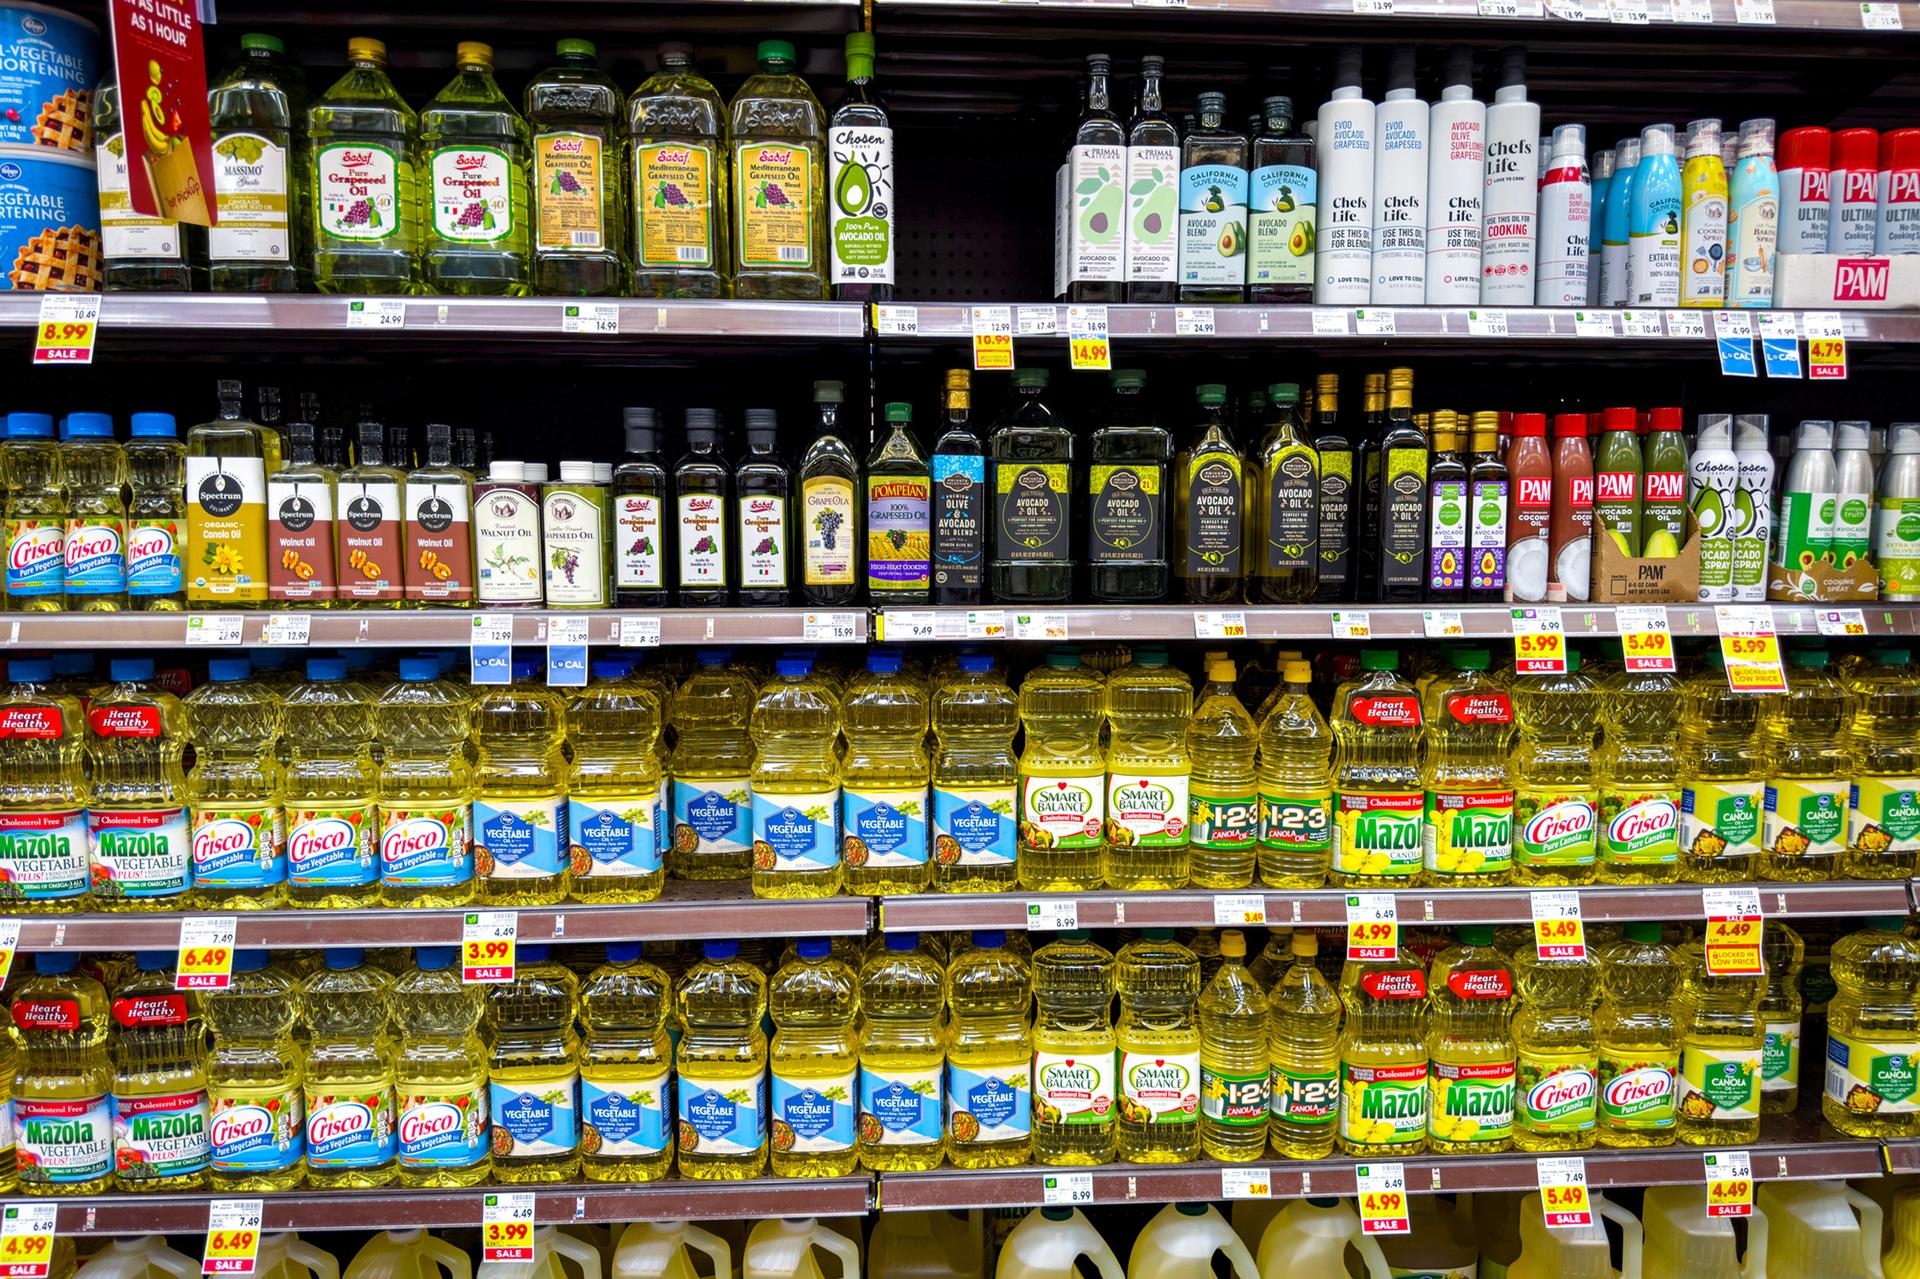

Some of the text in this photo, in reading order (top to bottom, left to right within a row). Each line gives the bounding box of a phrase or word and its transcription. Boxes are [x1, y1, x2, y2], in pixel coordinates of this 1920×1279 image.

[1373, 2, 1392, 10] 13.99
[136, 1, 191, 30] AS LITTLE
[131, 16, 186, 47] AS 1 HOUR
[1386, 121, 1403, 131] EVOO
[836, 132, 885, 145] Chosen
[1385, 131, 1415, 140] AVOCADO
[1385, 141, 1422, 150] GRAPESEED
[224, 165, 262, 176] MASSIMO
[648, 165, 699, 173] Mediterranean
[1488, 158, 1517, 175] Life
[329, 174, 386, 186] Grapeseed
[1191, 171, 1238, 182] CALIFORNIA
[1193, 178, 1237, 188] OLIVE RANCH
[350, 186, 368, 196] Oil
[1384, 209, 1409, 221] Life
[1187, 220, 1216, 228] AVOCADO
[1187, 228, 1207, 236] BLEND
[1488, 224, 1527, 237] COOKING
[839, 231, 886, 242] AVOCADO OIL
[1836, 266, 1887, 298] PAM
[75, 310, 96, 319] 10.49
[381, 316, 401, 324] 24.99
[596, 322, 616, 330] 14.99
[897, 324, 916, 332] 18.99
[1088, 322, 1106, 330] 18.99
[1643, 325, 1660, 333] 10.49
[1686, 326, 1703, 334] 7.99
[44, 325, 87, 340] 8.99
[1824, 328, 1841, 336] 5.49
[977, 335, 1010, 345] 10.99
[47, 350, 76, 358] SALE
[1072, 346, 1107, 360] 14.99
[1811, 343, 1842, 357] 4.79
[1816, 367, 1838, 375] SALE
[1696, 462, 1734, 472] Chosen
[1599, 475, 1634, 494] PAM
[1647, 475, 1683, 495] PAM
[201, 492, 241, 501] Spectrum
[875, 486, 924, 498] POMPEIAN
[1279, 489, 1312, 498] AVOCADO
[946, 499, 968, 509] OLIVE
[1017, 499, 1049, 508] AVOCADO
[1290, 498, 1301, 507] OIL
[939, 518, 975, 529] AVOCADO
[203, 530, 241, 539] Canola Oil
[348, 538, 382, 547] Walnut Oil
[66, 538, 112, 565] Crisco
[68, 557, 111, 575] Pure Vegetable
[1639, 566, 1664, 580] PAM
[913, 626, 932, 634] 9.49
[1225, 626, 1243, 635] 17.99
[1541, 622, 1559, 630] 6.99
[1846, 625, 1864, 633] 5.29
[492, 632, 511, 640] 12.99
[834, 628, 852, 636] 15.99
[1520, 636, 1558, 651] 5.99
[1628, 635, 1665, 649] 5.49
[1733, 640, 1765, 653] 5.99
[1528, 661, 1554, 669] SALE
[1373, 701, 1403, 709] Heart
[109, 710, 141, 718] Heart
[1368, 708, 1410, 717] Healthy
[103, 719, 148, 728] Healthy
[1040, 792, 1082, 802] SMART
[1038, 801, 1086, 812] BALANCE
[102, 816, 159, 824] Cholesterol Free
[1723, 812, 1753, 820] CANOLA
[768, 825, 812, 834] VEGETABLE
[1534, 814, 1585, 843] Crisco
[486, 830, 531, 839] VEGETABLE
[1269, 829, 1307, 841] CANOLA OIL
[101, 832, 168, 856] Mazola
[381, 830, 437, 862] Crisco
[114, 857, 182, 868] VEGETABLE
[389, 852, 436, 871] Pure Vegetable
[118, 871, 143, 879] PLUS!
[1245, 913, 1263, 922] 3.49
[1057, 919, 1074, 927] 8.99
[1354, 925, 1391, 939] 4.99
[1541, 922, 1576, 936] 5.49
[1717, 924, 1750, 936] 4.49
[469, 943, 508, 958] 3.99
[1360, 949, 1385, 957] SALE
[184, 950, 226, 966] 6.49
[476, 969, 502, 977] SALE
[189, 977, 216, 985] SALE
[1469, 974, 1497, 982] Heart
[1464, 981, 1504, 990] Healthy
[31, 1005, 61, 1013] Heart
[25, 1013, 68, 1021] Healthy
[1138, 1068, 1180, 1079] SMART
[1136, 1079, 1183, 1089] BALANCE
[1711, 1078, 1746, 1086] CANOLA
[505, 1110, 549, 1118] VEGETABLE
[27, 1120, 93, 1144] Mazola
[310, 1115, 361, 1144] Crisco
[1713, 1184, 1747, 1196] 4.49
[1548, 1189, 1582, 1204] 5.49
[1366, 1195, 1400, 1210] 4.99
[1718, 1206, 1741, 1214] SALE
[1557, 1215, 1581, 1223] SALE
[1373, 1221, 1398, 1229] SALE
[490, 1225, 527, 1239] 3.99
[212, 1233, 252, 1249] 6.49
[6, 1238, 46, 1254] 4.99
[9, 1266, 36, 1274] SALE
